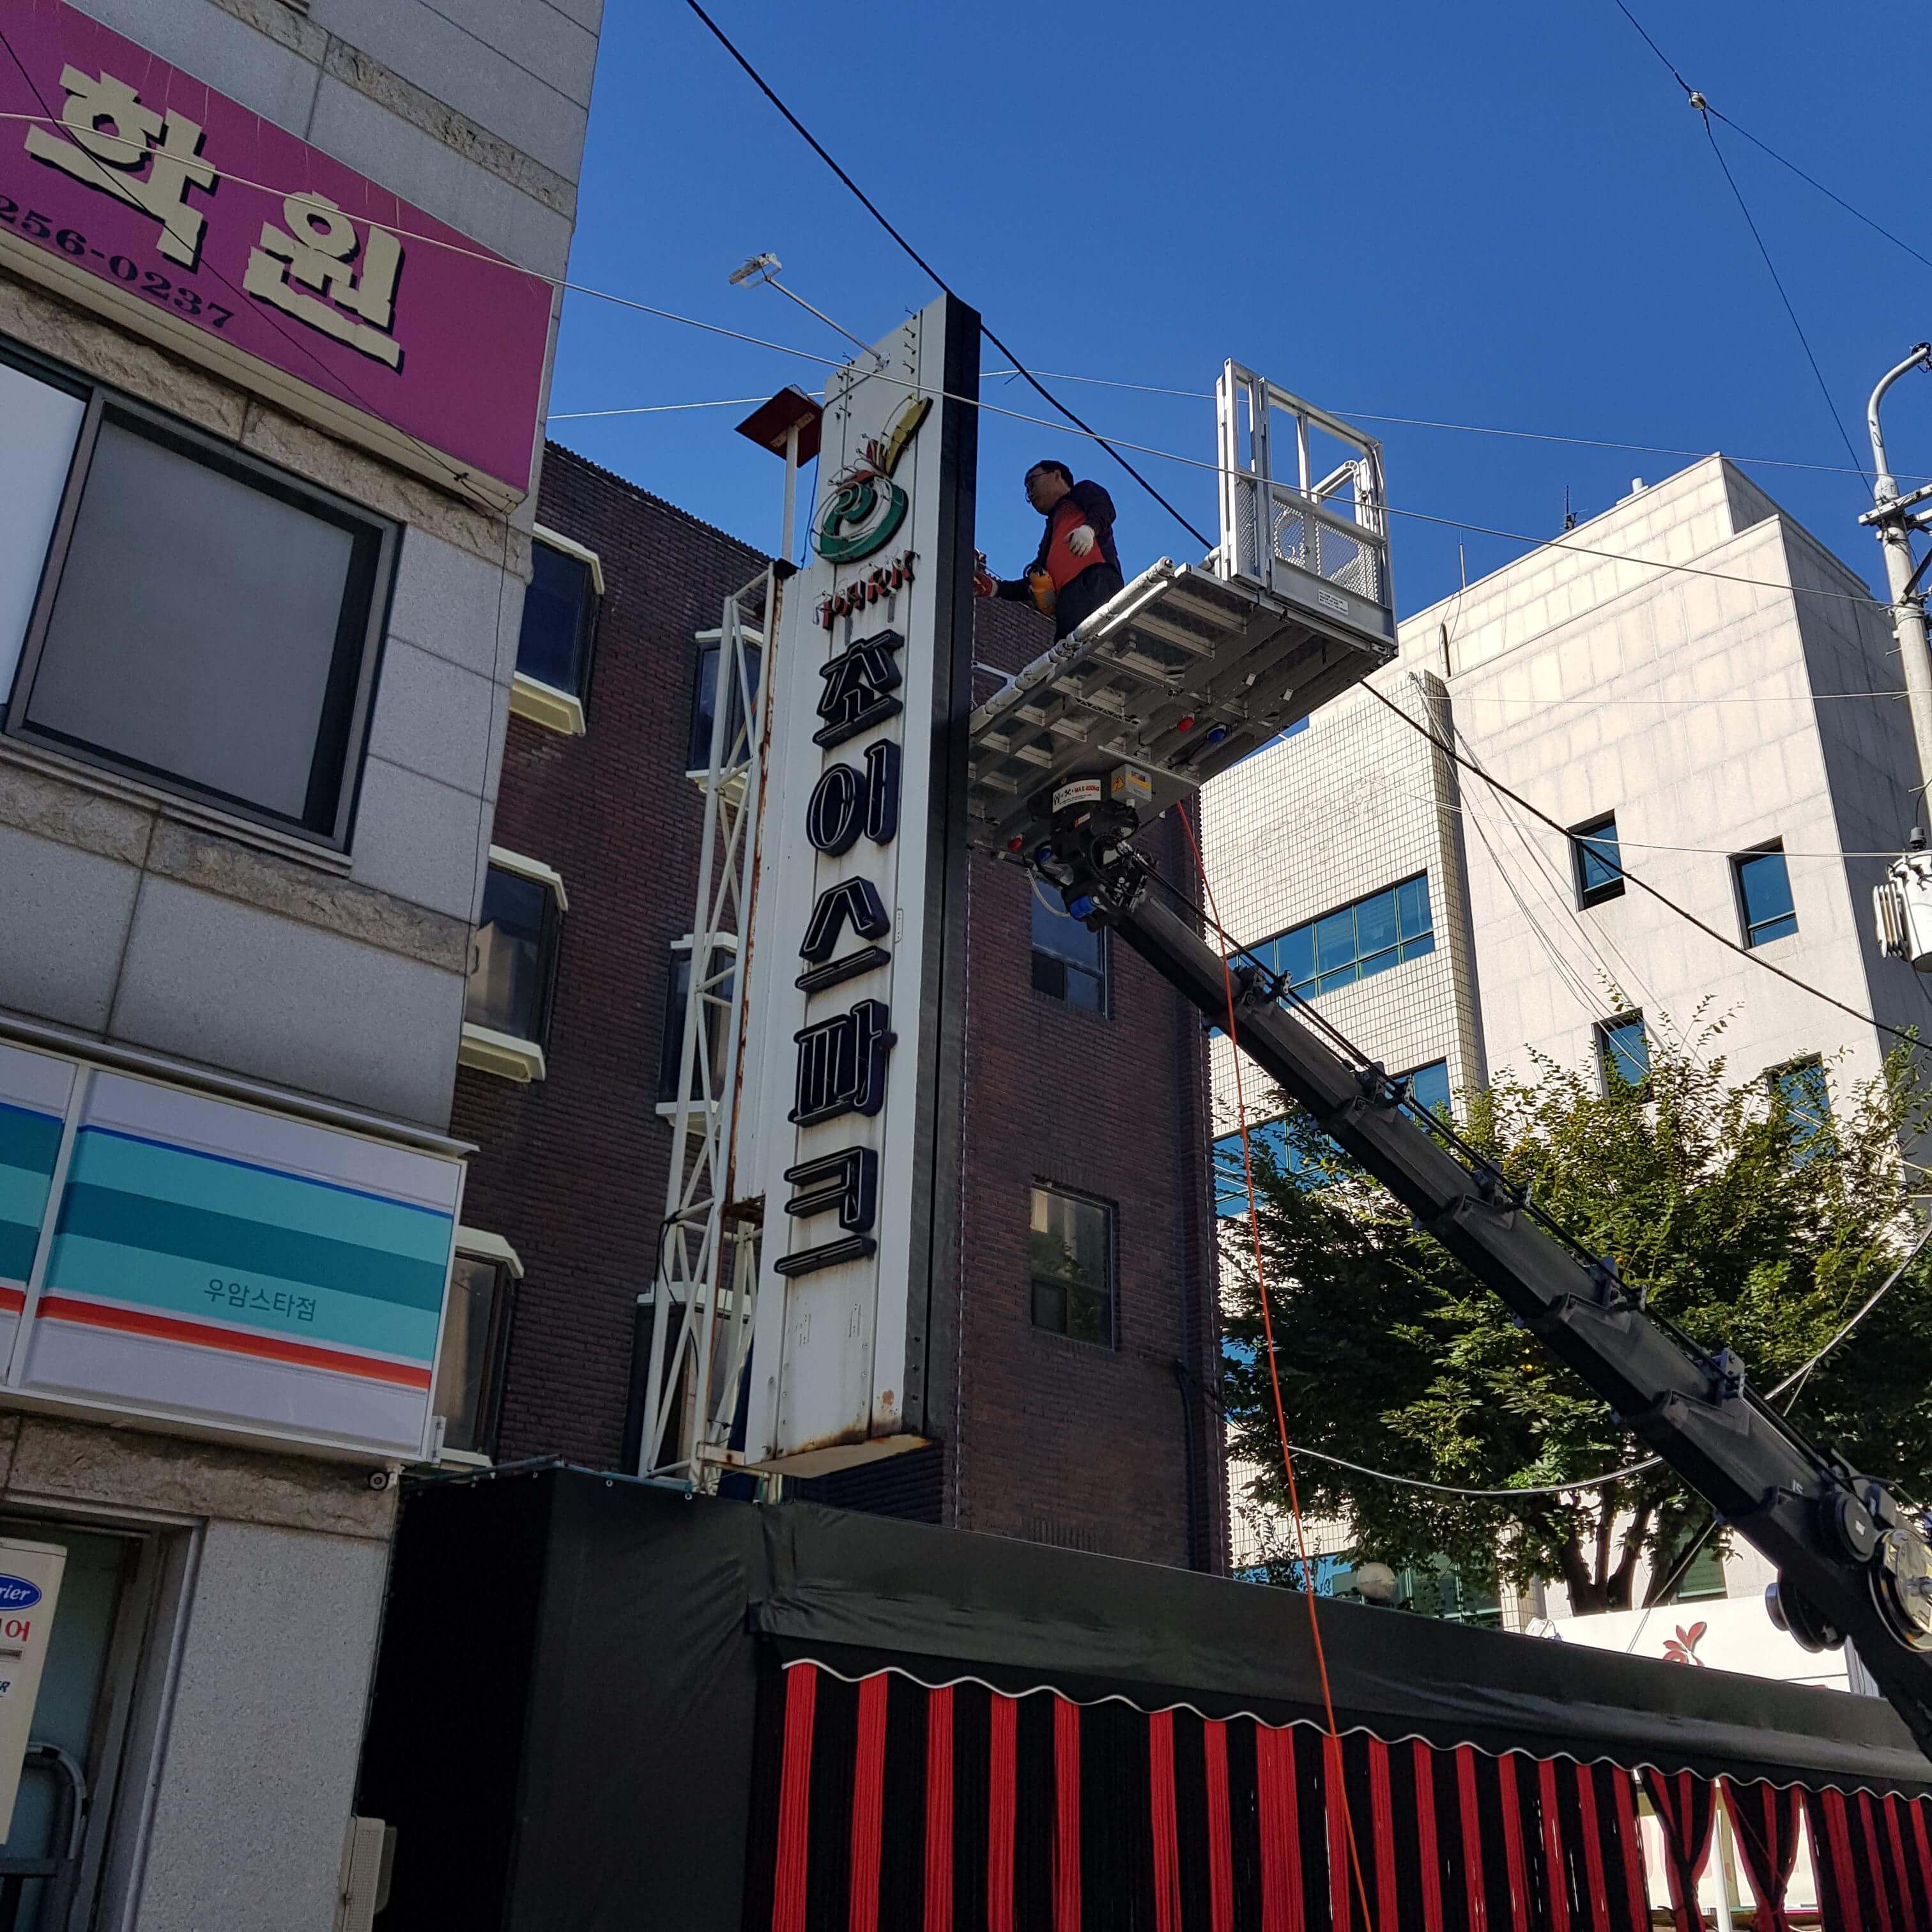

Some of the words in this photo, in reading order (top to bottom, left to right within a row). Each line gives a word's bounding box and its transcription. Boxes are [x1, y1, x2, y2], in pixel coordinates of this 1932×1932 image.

[0, 194, 234, 328] 256-0237
[24, 63, 403, 374] 학원
[774, 629, 905, 1278] 초이스파크
[204, 1278, 317, 1322] 우암스타점
